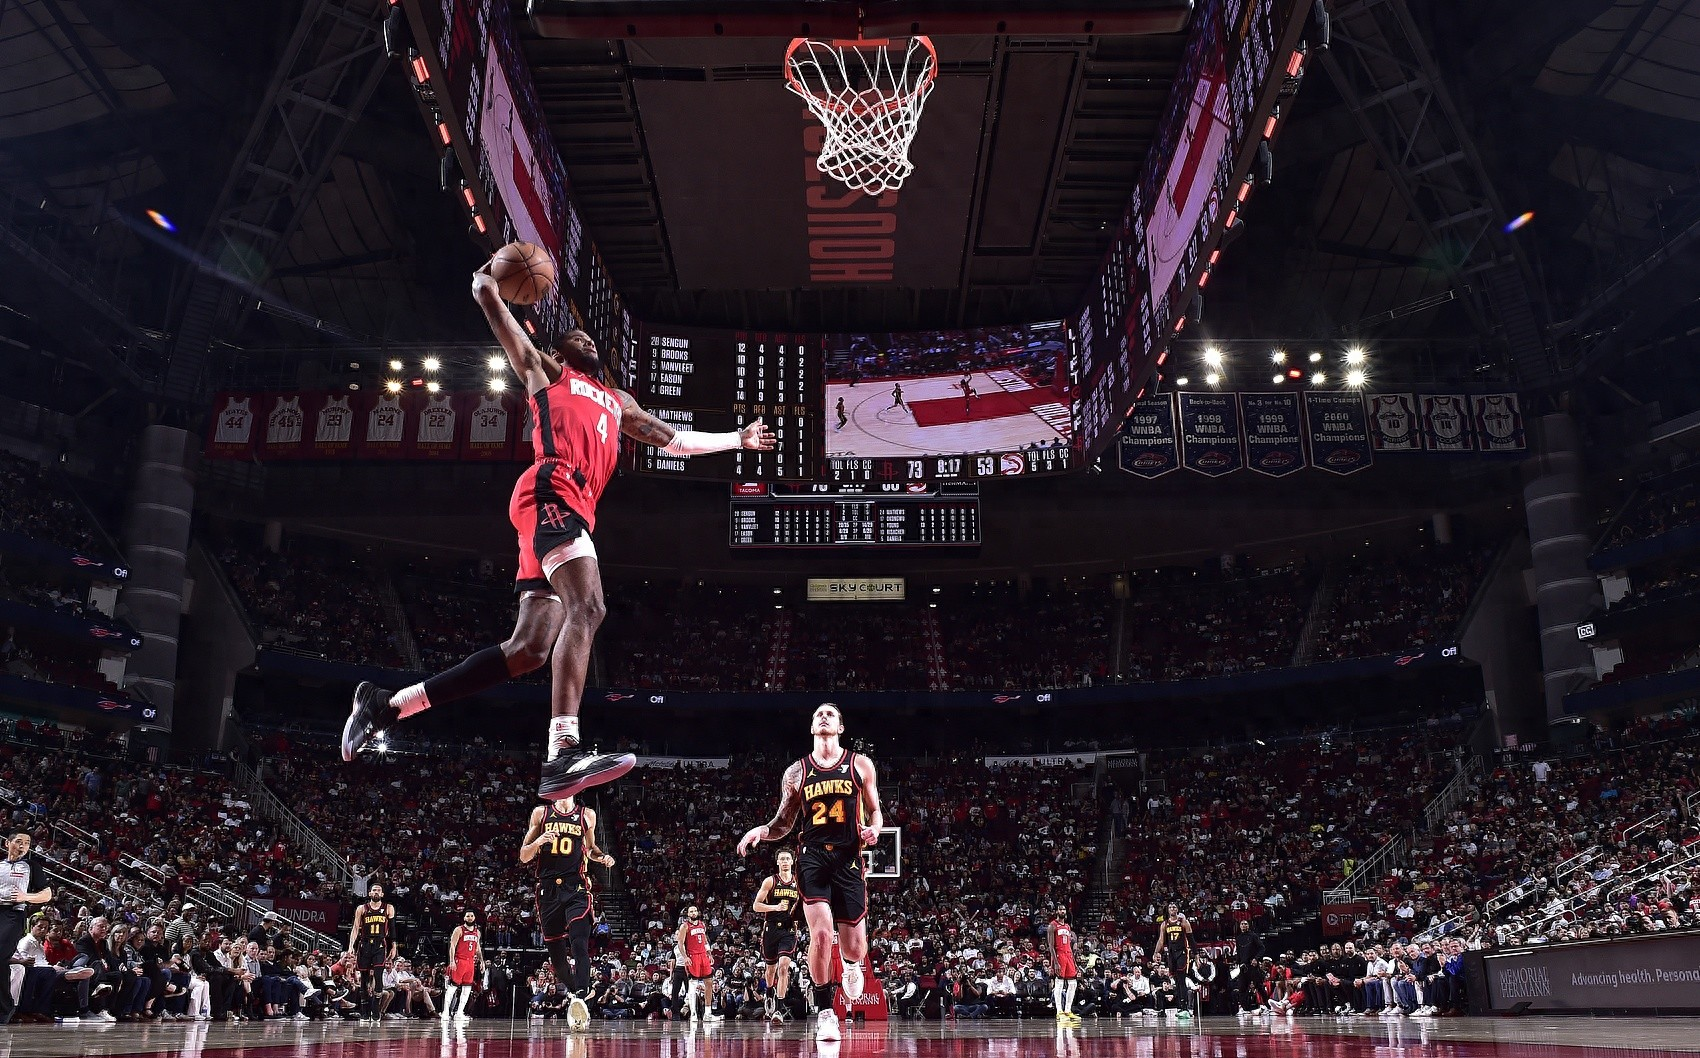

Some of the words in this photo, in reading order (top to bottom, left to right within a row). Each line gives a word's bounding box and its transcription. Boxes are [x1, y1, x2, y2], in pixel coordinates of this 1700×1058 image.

[651, 336, 659, 346] 28
[662, 338, 688, 349] SENGUN
[738, 343, 745, 352] 12
[759, 344, 764, 354] 4
[779, 345, 784, 354] 4
[799, 346, 804, 355] 0
[652, 349, 657, 358] 9
[661, 350, 688, 360] BROOKS
[737, 355, 745, 364] 10
[759, 356, 764, 365] 0
[779, 357, 783, 366] 2
[799, 358, 804, 367] 2
[660, 362, 694, 373] VANVLEET
[737, 367, 745, 376] 10
[759, 368, 764, 377] 3
[780, 369, 783, 378] 1
[799, 370, 804, 379] 2
[650, 373, 657, 381] 17
[660, 374, 683, 384] EASON
[758, 380, 764, 389] 11
[778, 381, 783, 390] 0
[799, 382, 804, 391] 2
[650, 385, 655, 394] 4
[660, 385, 681, 396] GREEN
[758, 392, 764, 401] 9
[778, 393, 784, 402] 3
[799, 394, 803, 403] 1
[423, 407, 452, 416] DREXLER
[733, 404, 746, 414] PTS
[773, 406, 786, 416] AST
[794, 406, 805, 416] FLS
[225, 416, 243, 429] 44
[278, 415, 294, 427] 45
[327, 414, 342, 427] 23
[377, 414, 394, 426] 24
[428, 415, 446, 427] 22
[480, 415, 498, 427] 34
[659, 409, 693, 421] MATHEWS
[737, 415, 743, 425] 0
[778, 417, 783, 427] 0
[799, 418, 803, 427] 0
[1133, 415, 1158, 424] 1997
[1197, 414, 1222, 423] 1998
[1259, 414, 1284, 423] 1999
[597, 412, 608, 444] 4
[1131, 425, 1162, 435] WNBA
[1194, 425, 1226, 434] WNBA
[1256, 424, 1288, 434] WNBA
[1322, 422, 1353, 431] WNBA
[799, 430, 803, 439] 1
[1122, 435, 1173, 446] Champions
[1185, 434, 1237, 445] Champions
[1248, 435, 1299, 445] Champions
[1313, 433, 1365, 443] Champions
[799, 442, 803, 451] 1
[647, 446, 654, 455] 10
[758, 454, 762, 463] 1
[778, 454, 783, 464] 0
[799, 455, 802, 464] 1
[1027, 451, 1039, 462] TOL
[1042, 450, 1055, 460] FLS
[1059, 448, 1068, 459] CC
[648, 460, 652, 469] 5
[657, 461, 685, 471] DANIELS
[736, 466, 741, 475] 4
[757, 467, 762, 476] 4
[778, 467, 783, 476] 5
[799, 468, 802, 477] 1
[832, 461, 843, 470] TOL
[846, 460, 858, 470] FLS
[862, 460, 872, 470] CC
[907, 461, 923, 479] 73
[938, 458, 960, 474] 8:17
[977, 457, 994, 476] 53
[1032, 462, 1037, 472] 5
[1047, 460, 1052, 470] 3
[1063, 458, 1066, 469] 1
[835, 470, 840, 480] 2
[851, 471, 855, 480] 1
[865, 470, 870, 480] 0
[830, 584, 856, 592] SKY
[1580, 626, 1592, 635] CC
[804, 779, 852, 801] HAWKS
[812, 799, 845, 825] 24
[544, 822, 582, 836] HAWKS
[551, 836, 572, 855] 10
[774, 888, 798, 898] HAWKS
[278, 908, 326, 923] TUNDRA
[365, 915, 386, 924] HAWKS
[370, 924, 379, 934] 11
[698, 934, 702, 944] 9
[1170, 932, 1180, 941] 17
[468, 942, 473, 951] 5
[1499, 966, 1550, 984] MEMORIAL
[1571, 972, 1618, 987] Advancing
[1619, 969, 1655, 984] health.
[1501, 981, 1552, 998] HERMANN
